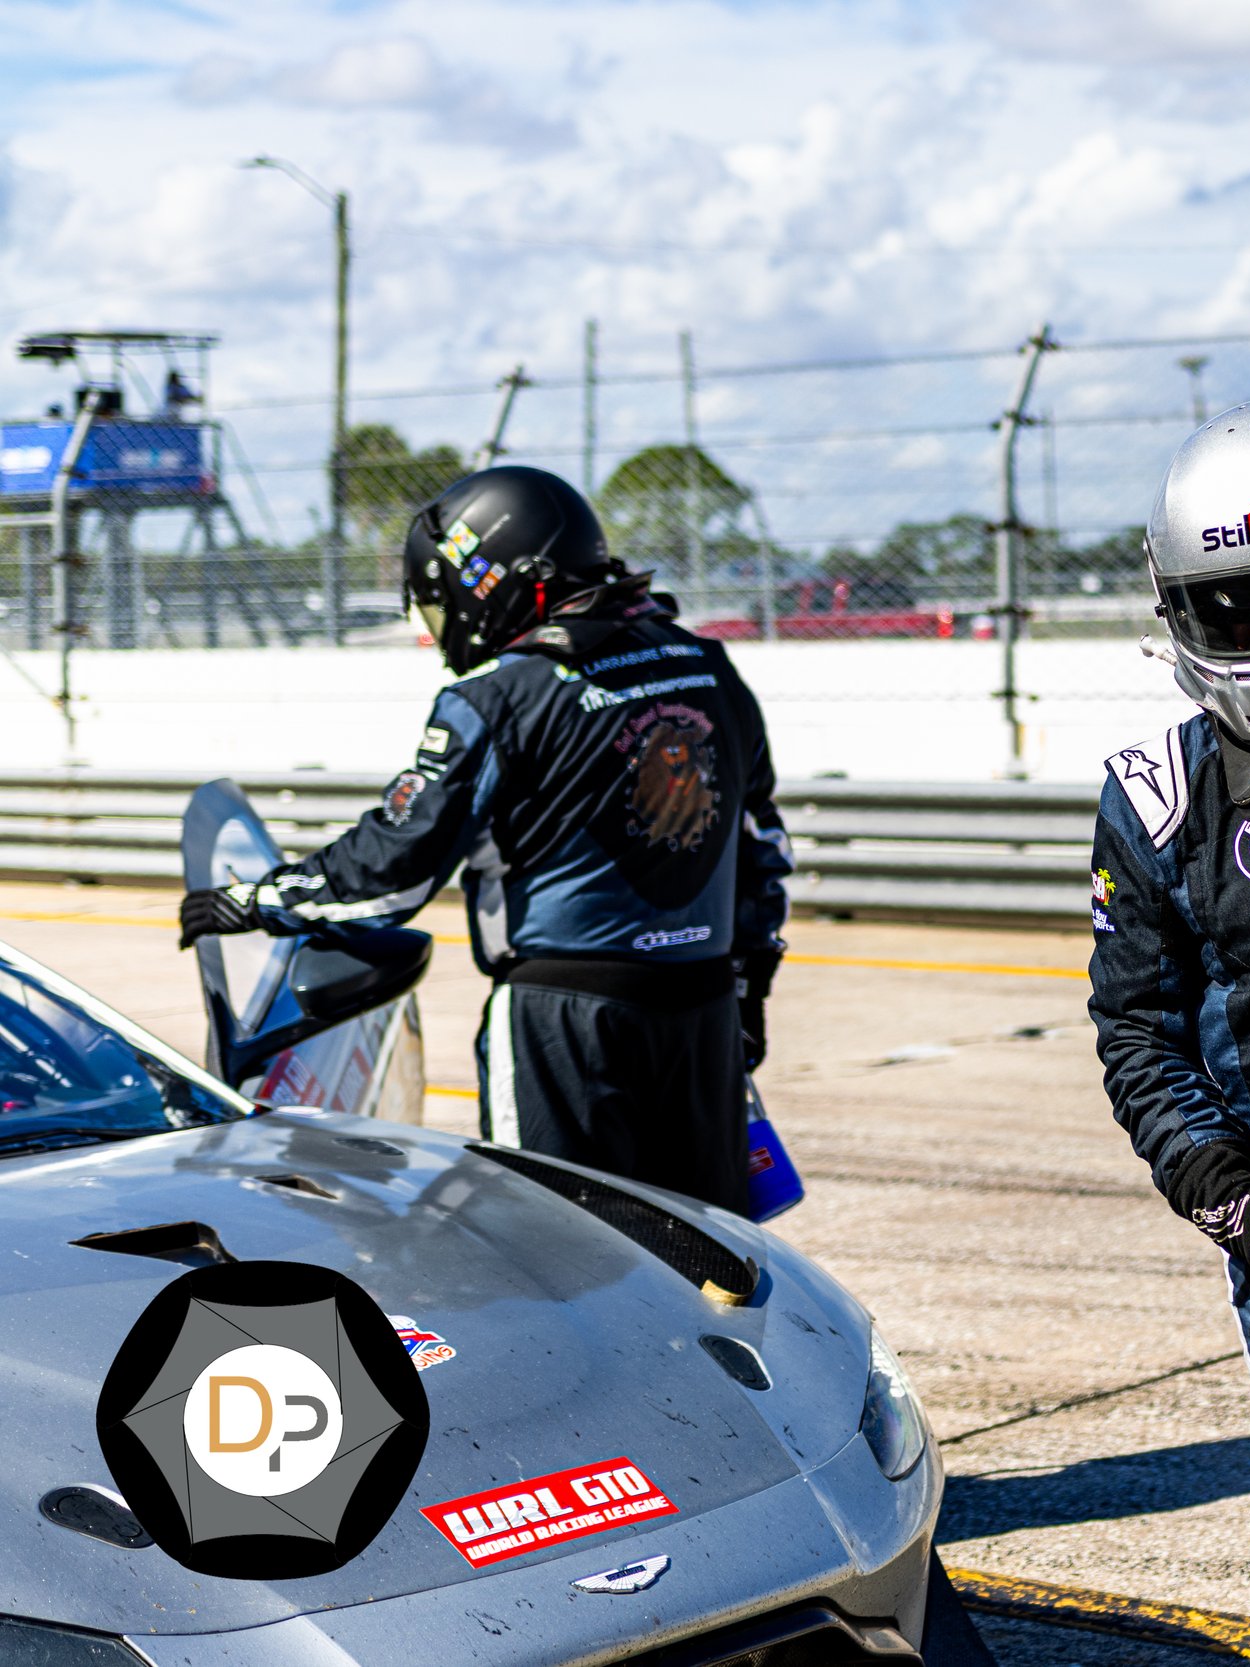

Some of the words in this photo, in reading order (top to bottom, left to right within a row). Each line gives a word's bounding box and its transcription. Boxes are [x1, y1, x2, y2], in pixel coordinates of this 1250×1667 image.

[644, 674, 718, 697] COMPONENTS
[442, 1487, 574, 1544] WRL
[569, 1465, 651, 1508] GTO
[465, 1530, 536, 1561] WORLD
[537, 1511, 605, 1541] RACING
[602, 1495, 670, 1522] LEAGUE
